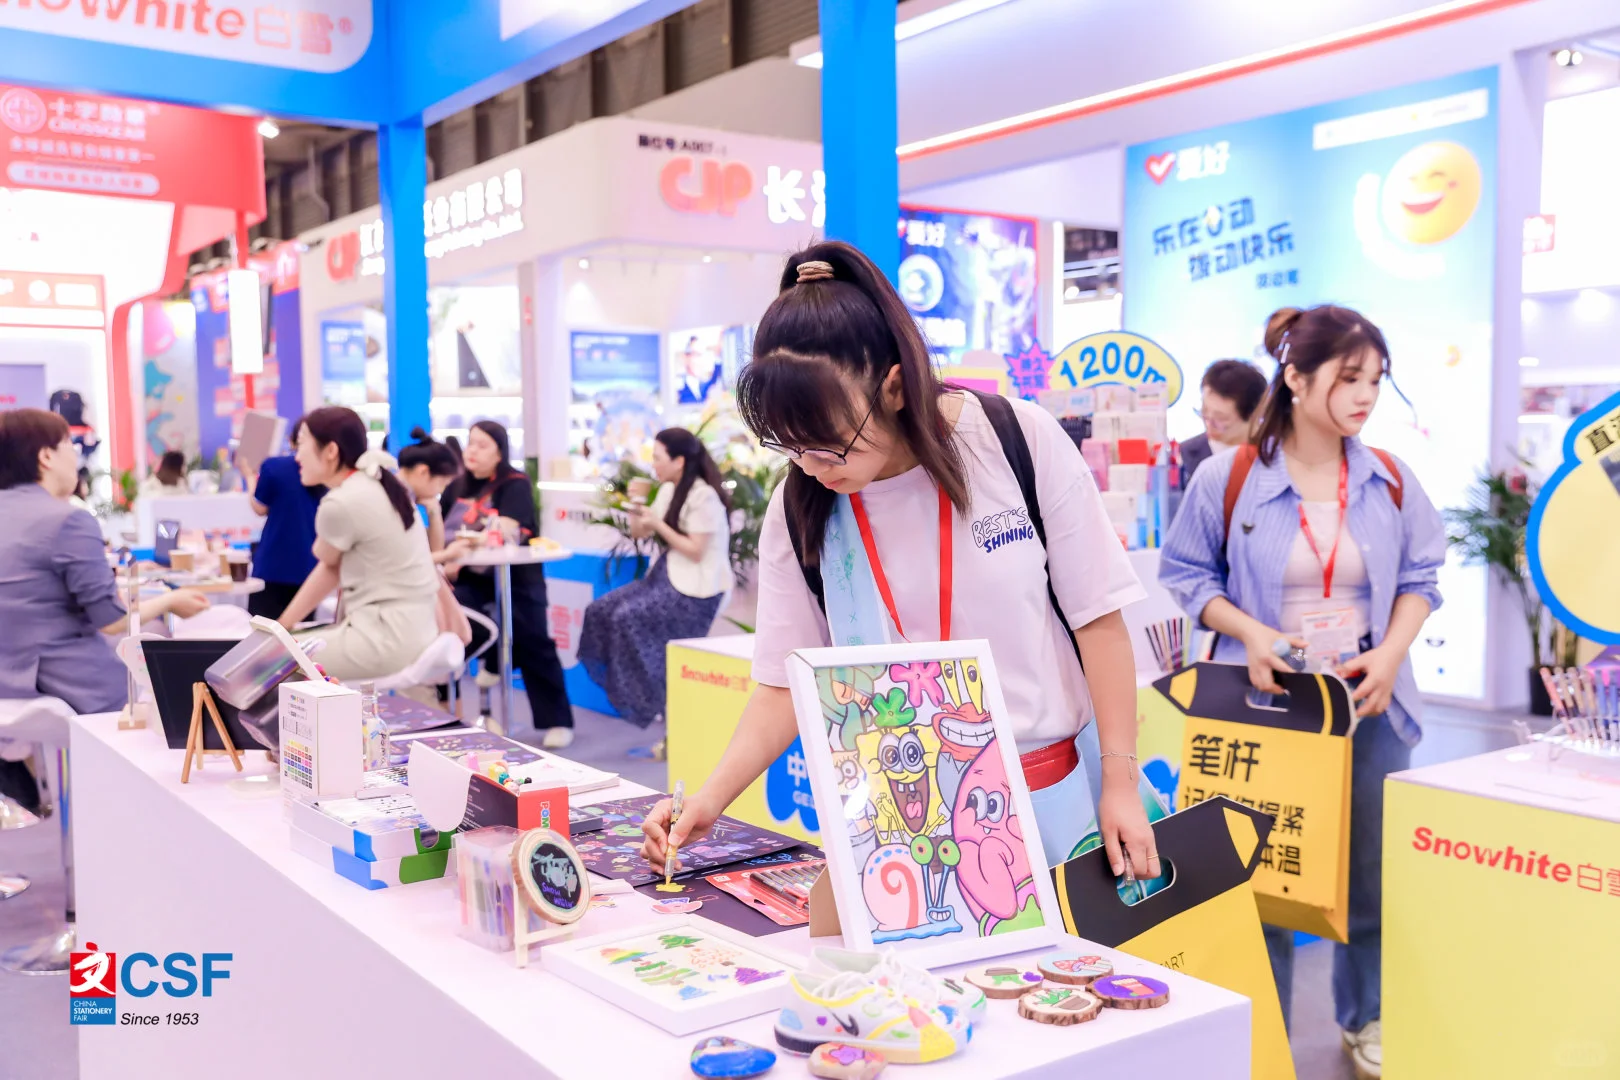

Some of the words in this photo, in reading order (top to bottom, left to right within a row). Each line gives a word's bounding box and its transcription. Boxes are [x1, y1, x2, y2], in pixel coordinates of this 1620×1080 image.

[763, 165, 826, 228] 长
[971, 506, 1029, 548] BEST'S
[983, 524, 1034, 553] SHINING
[1189, 734, 1261, 782] 笔杆
[1185, 785, 1305, 838] 记握紧
[1412, 826, 1572, 883] Snowhite
